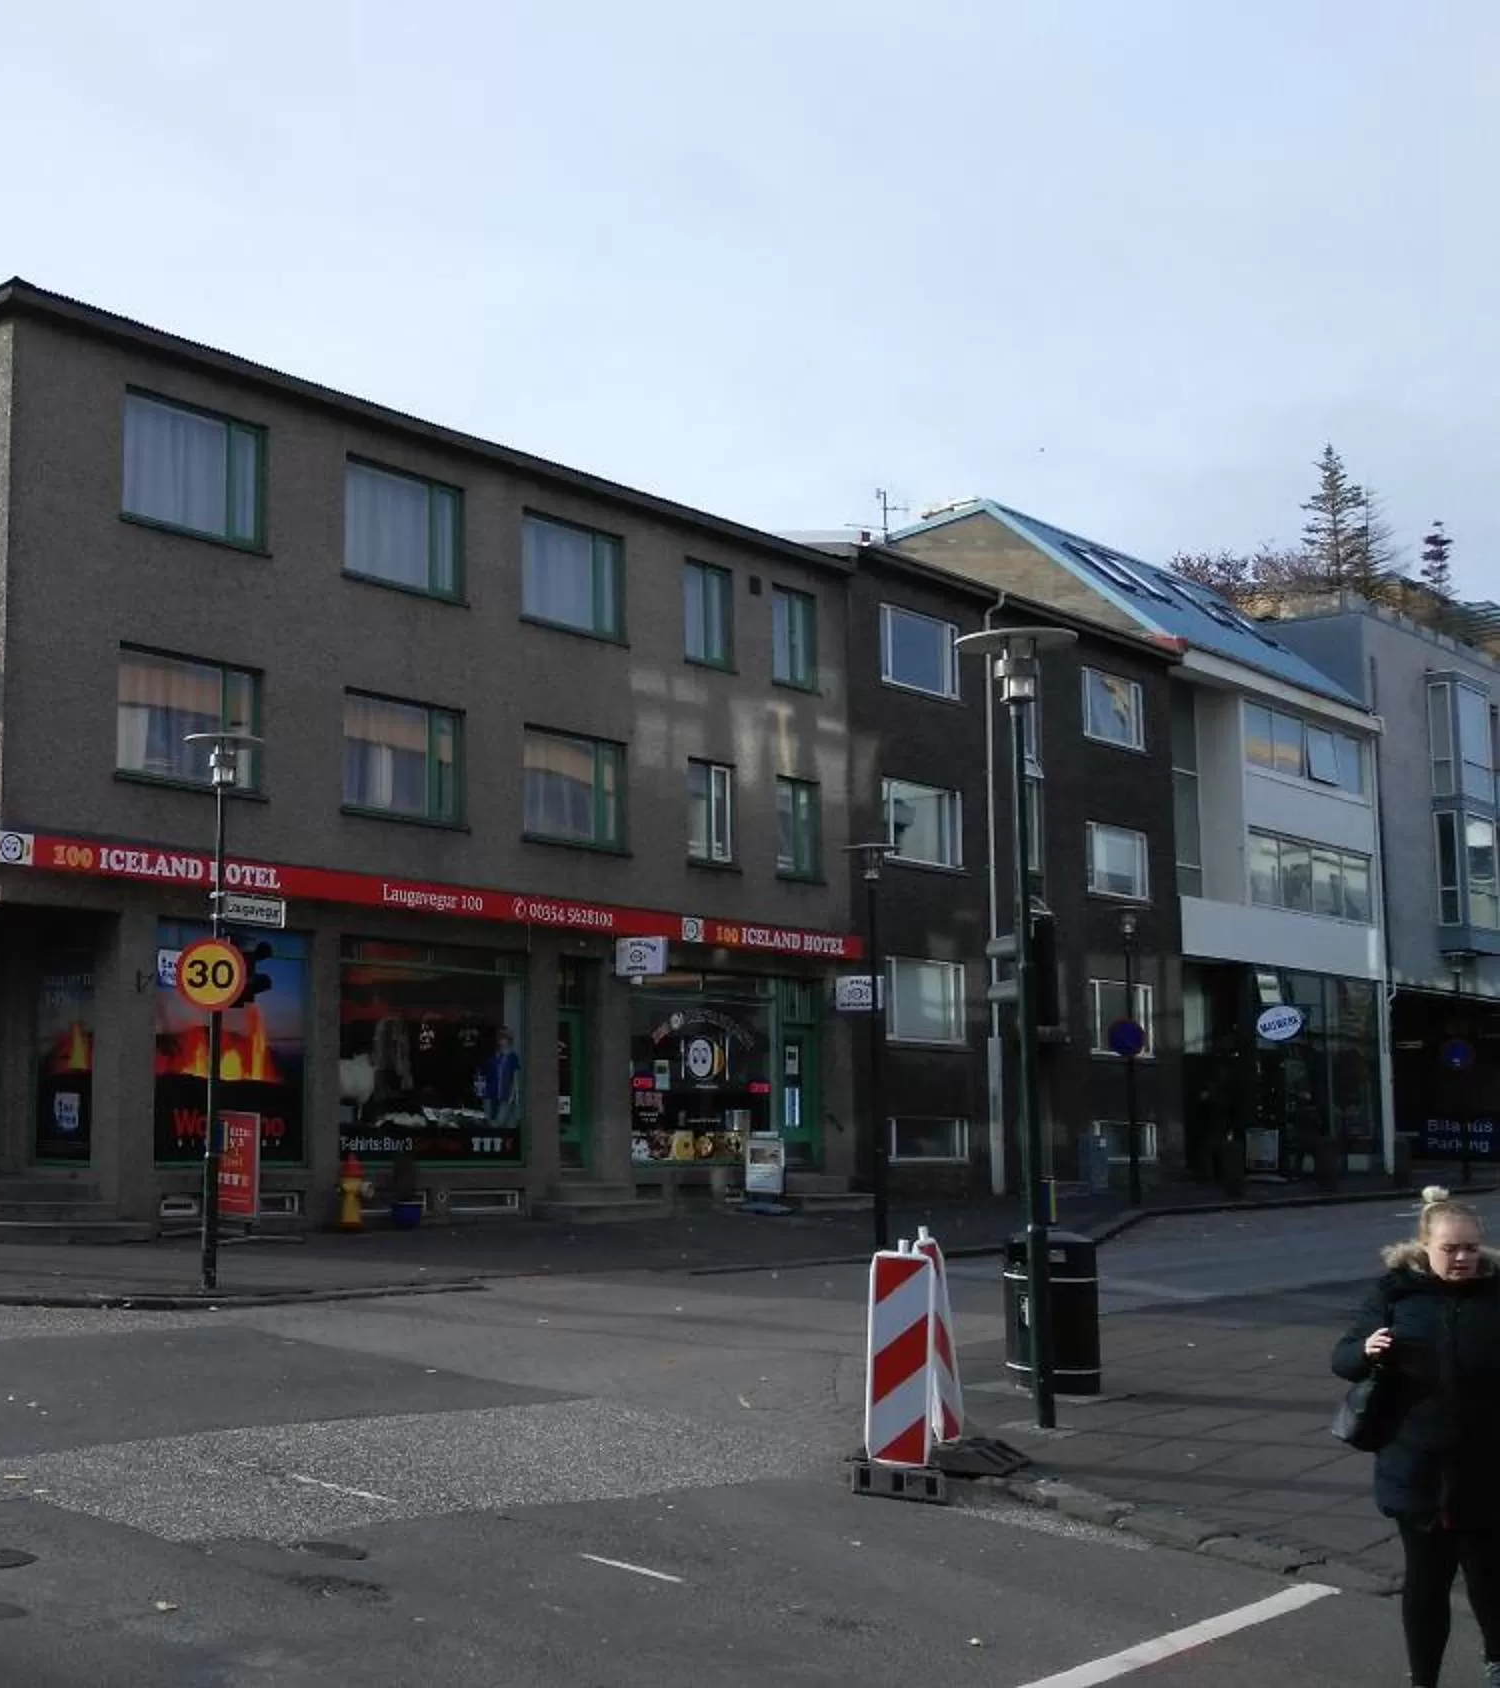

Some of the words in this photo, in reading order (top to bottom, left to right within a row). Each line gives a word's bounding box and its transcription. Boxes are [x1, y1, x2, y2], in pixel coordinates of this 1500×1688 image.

[53, 845, 93, 870] 100
[99, 847, 203, 880] ICELAND
[382, 883, 457, 911] Laugavegur
[460, 895, 483, 912] 100
[715, 925, 740, 943] 100
[741, 927, 801, 950] ICELAND
[803, 934, 845, 955] HOTEL
[187, 960, 234, 988] 30
[1427, 1137, 1491, 1153] Parkng
